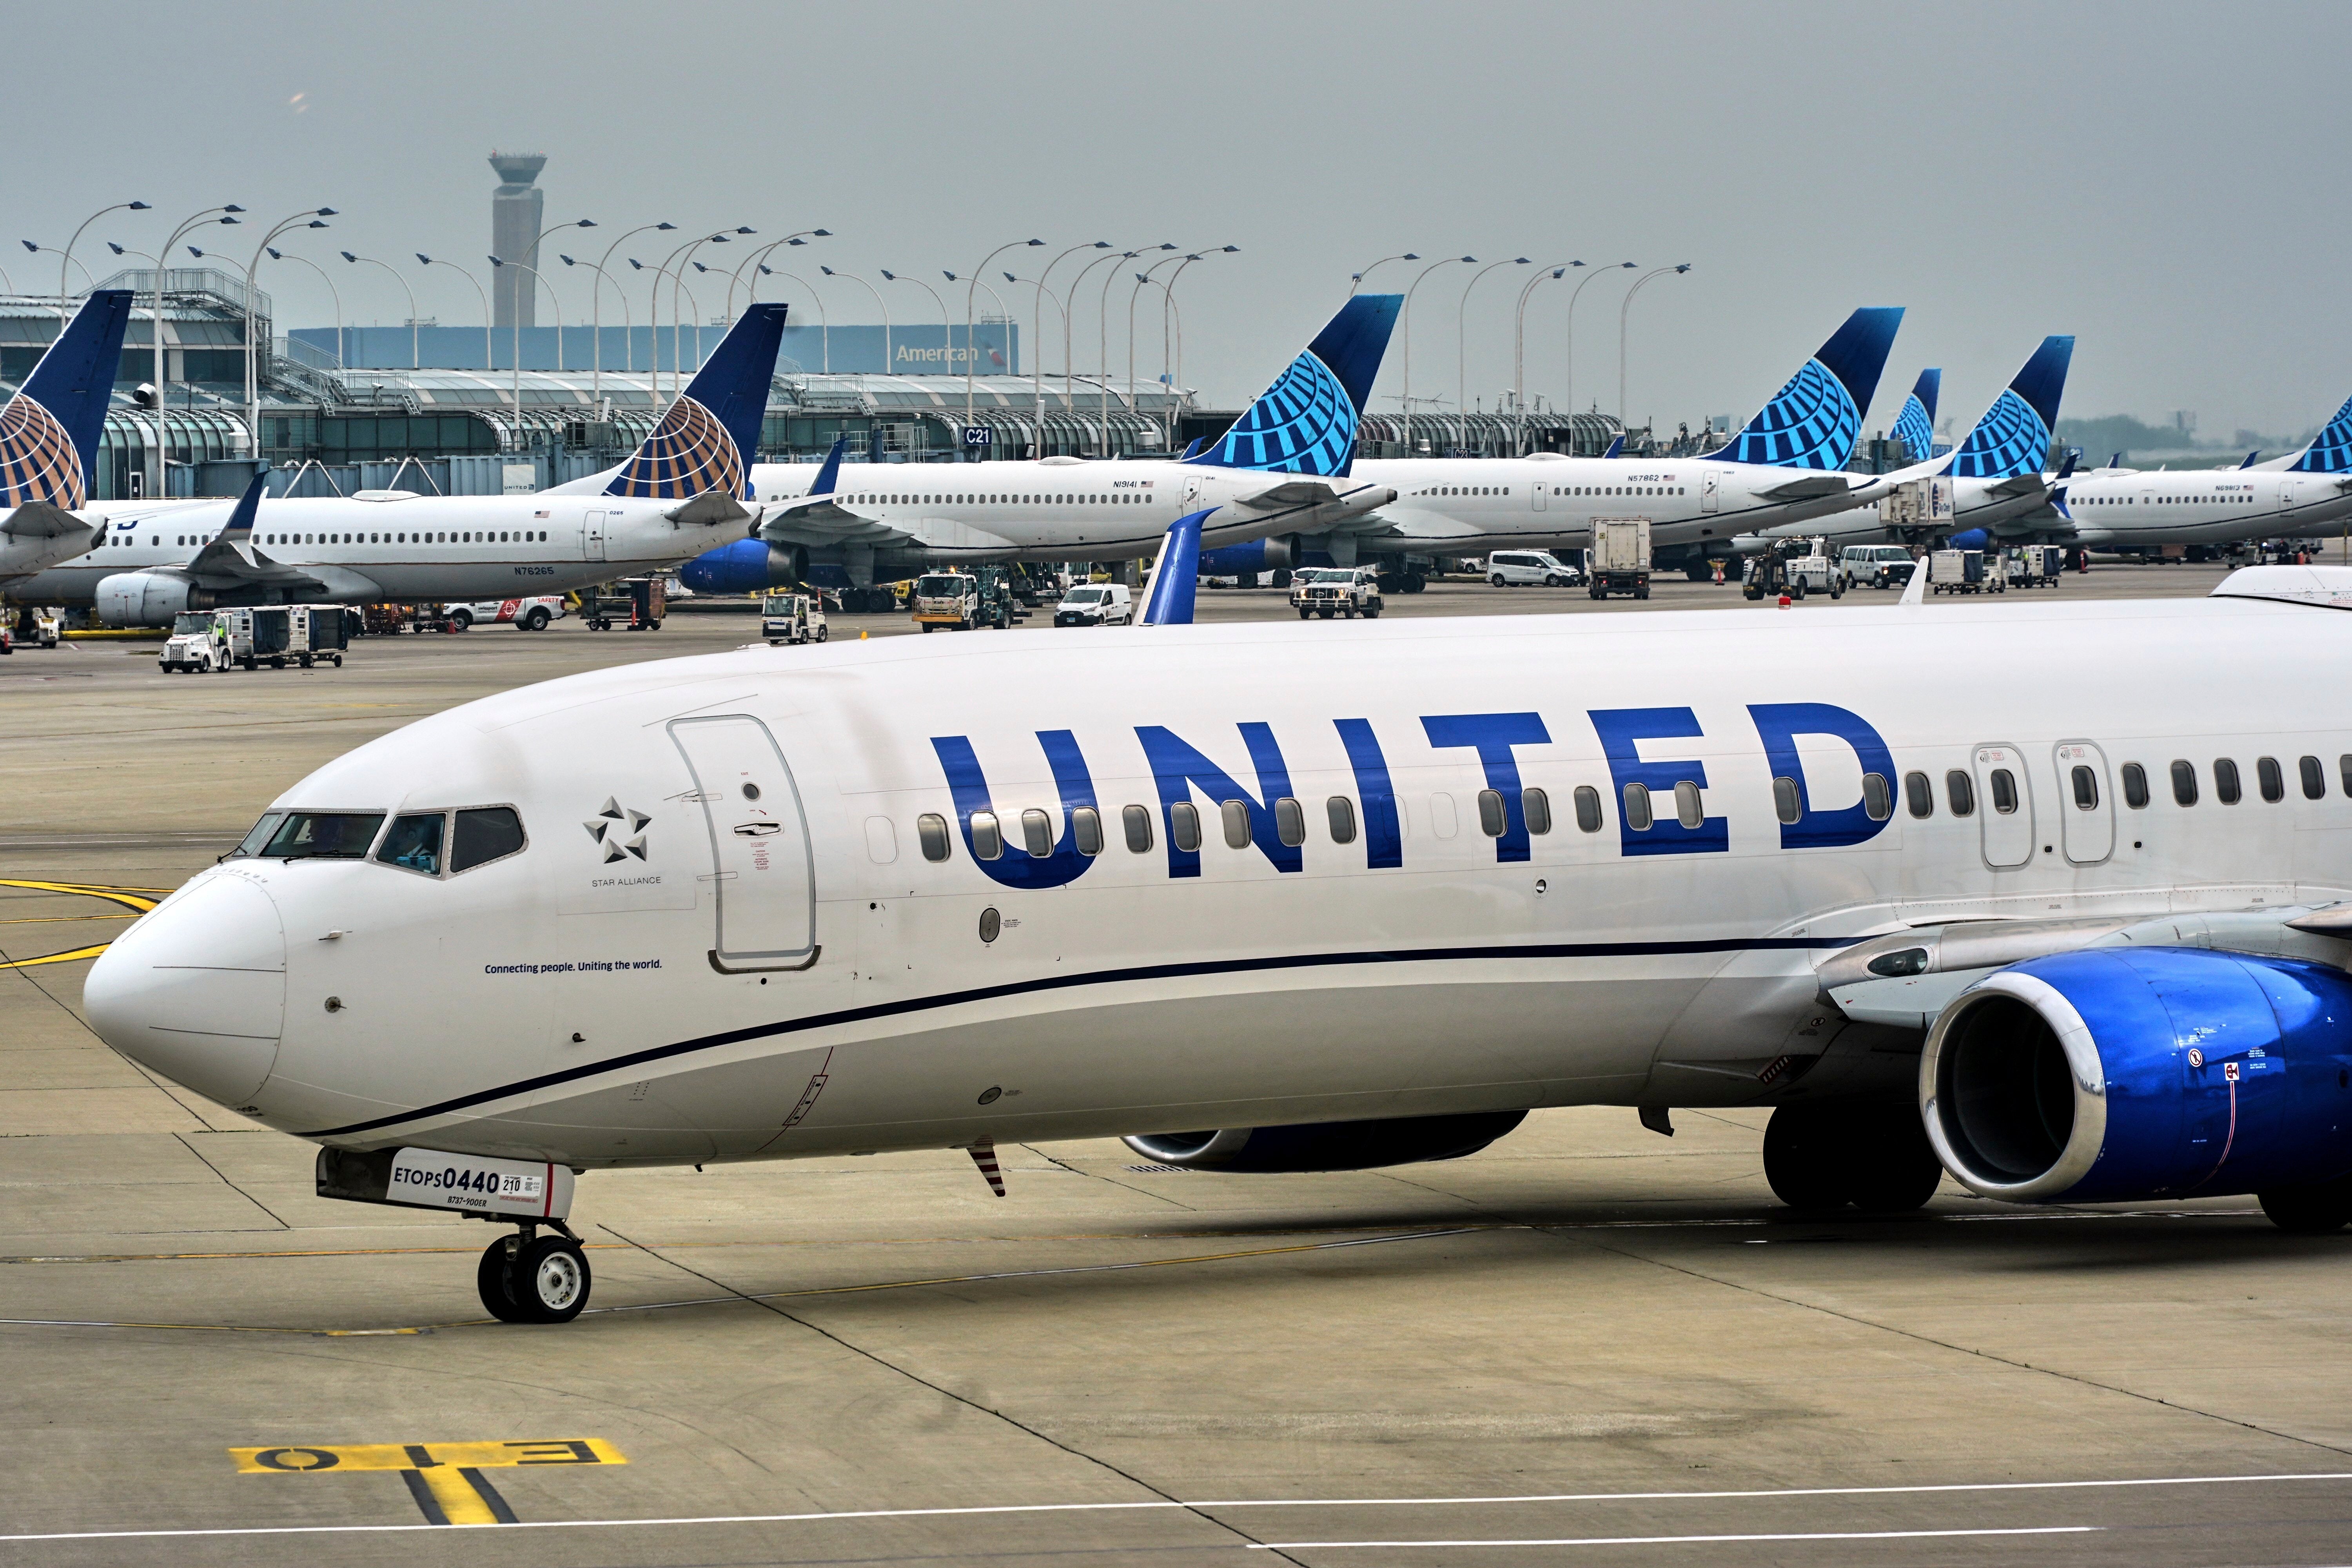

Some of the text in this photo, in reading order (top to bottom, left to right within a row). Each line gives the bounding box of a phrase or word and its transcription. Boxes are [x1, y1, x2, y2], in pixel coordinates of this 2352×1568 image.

[896, 345, 978, 361] American
[966, 428, 989, 443] C21
[1455, 449, 1468, 458] C23
[514, 567, 554, 575] N76265
[929, 702, 1898, 889] UNITED
[592, 877, 661, 887] STAR ALLIANCE
[485, 959, 662, 974] Connecting people. Uniting the world.
[503, 1179, 520, 1191] 210
[447, 1196, 487, 1207] B737-900ER
